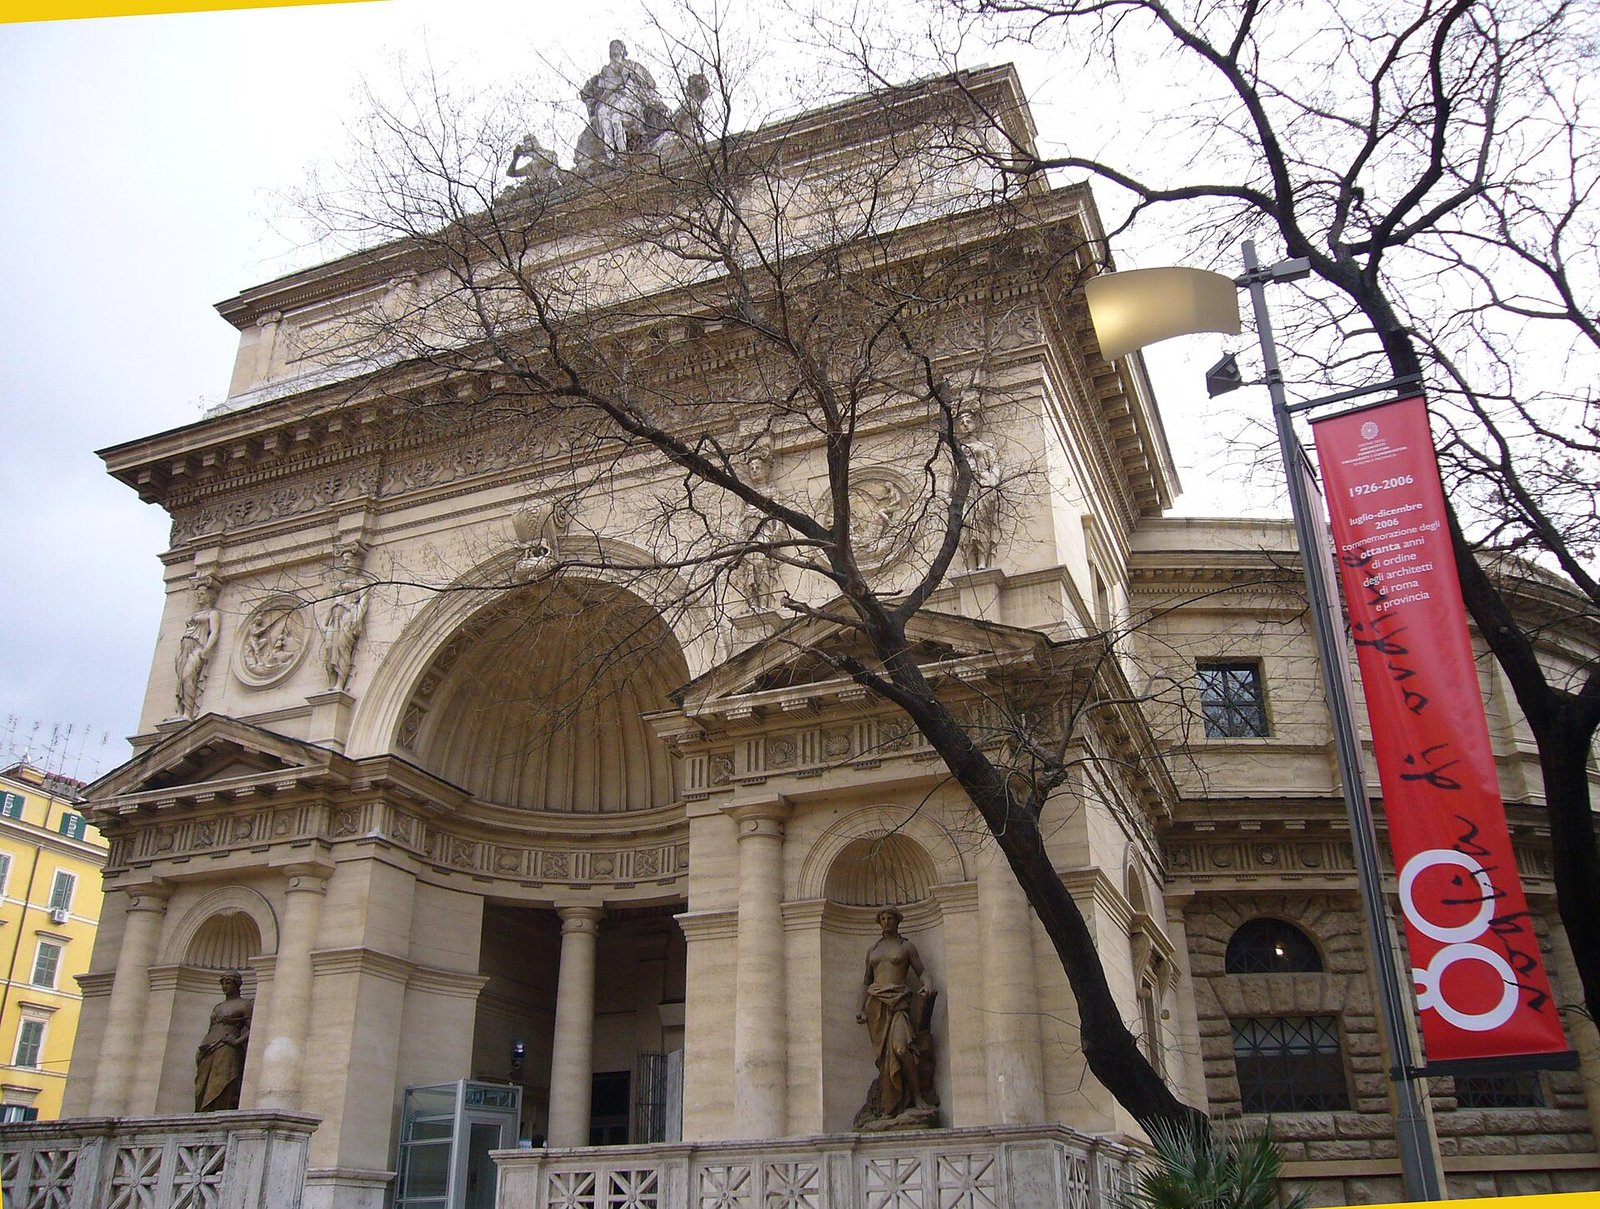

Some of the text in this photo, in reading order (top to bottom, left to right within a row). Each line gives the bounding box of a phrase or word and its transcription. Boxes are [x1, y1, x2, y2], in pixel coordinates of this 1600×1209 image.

[1349, 475, 1414, 498] 1926-2006
[1350, 502, 1423, 526] luglio-dicembre
[1375, 518, 1399, 530] 2006
[1342, 520, 1440, 551] commemorazione degli
[1360, 536, 1425, 559] ottanta anni
[1371, 552, 1417, 569] di ordine
[1363, 562, 1433, 587] degli architetti
[1379, 580, 1419, 596] di roma
[1376, 591, 1430, 612] e provincia
